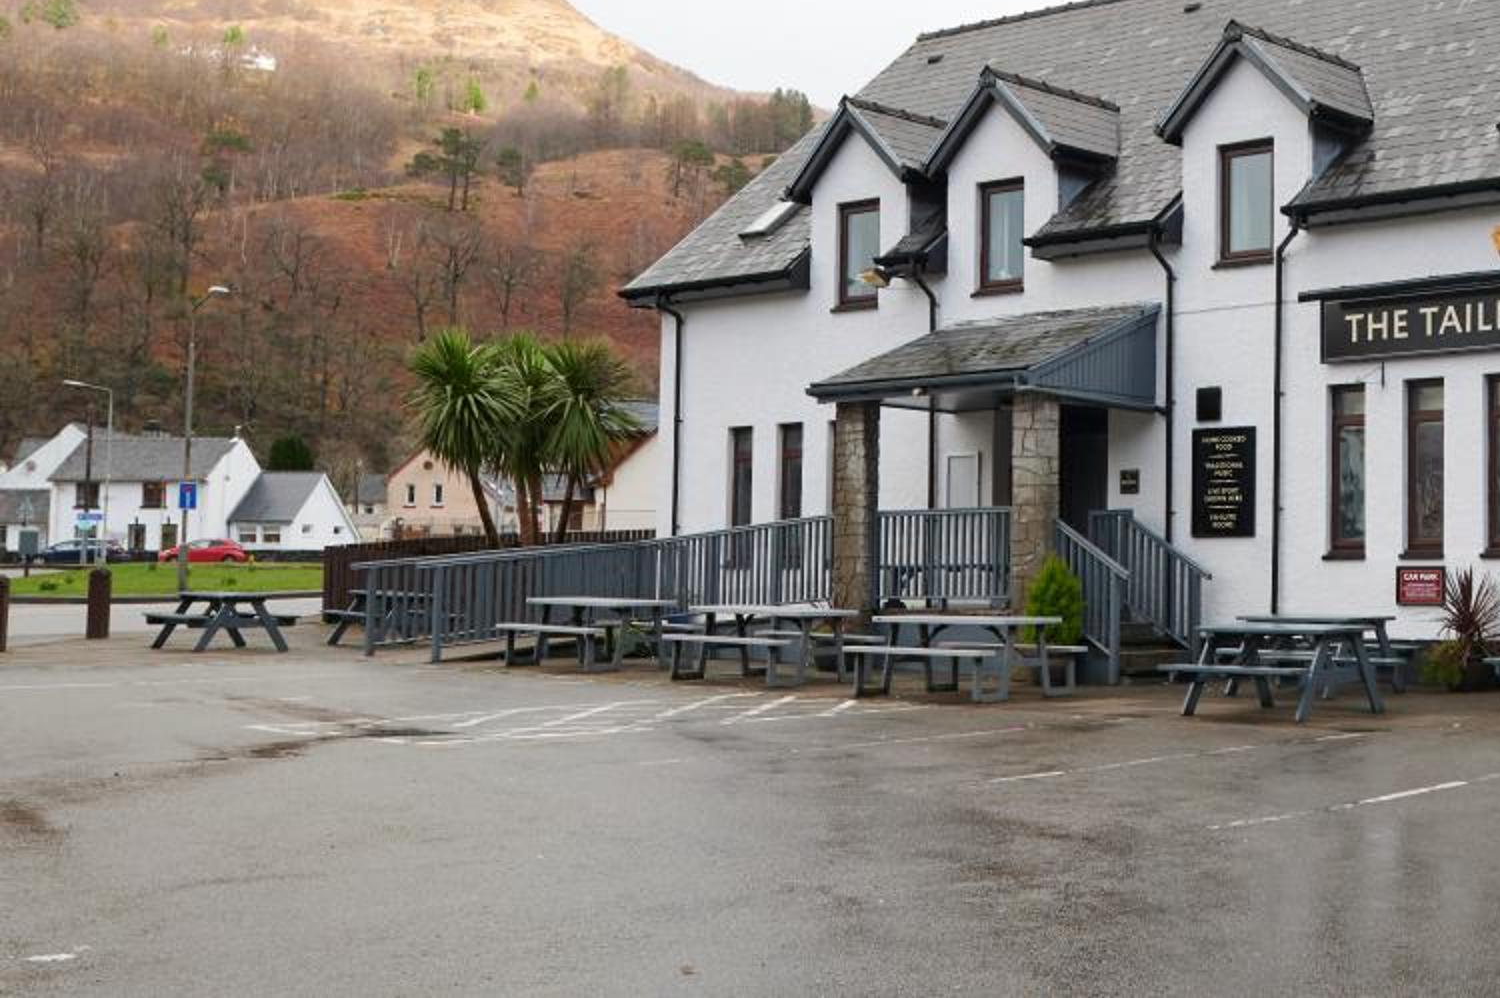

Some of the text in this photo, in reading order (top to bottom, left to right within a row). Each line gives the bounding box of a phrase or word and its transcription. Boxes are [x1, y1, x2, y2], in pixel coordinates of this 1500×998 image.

[1344, 309, 1408, 343] THE
[1403, 573, 1439, 581] CAR PARK
